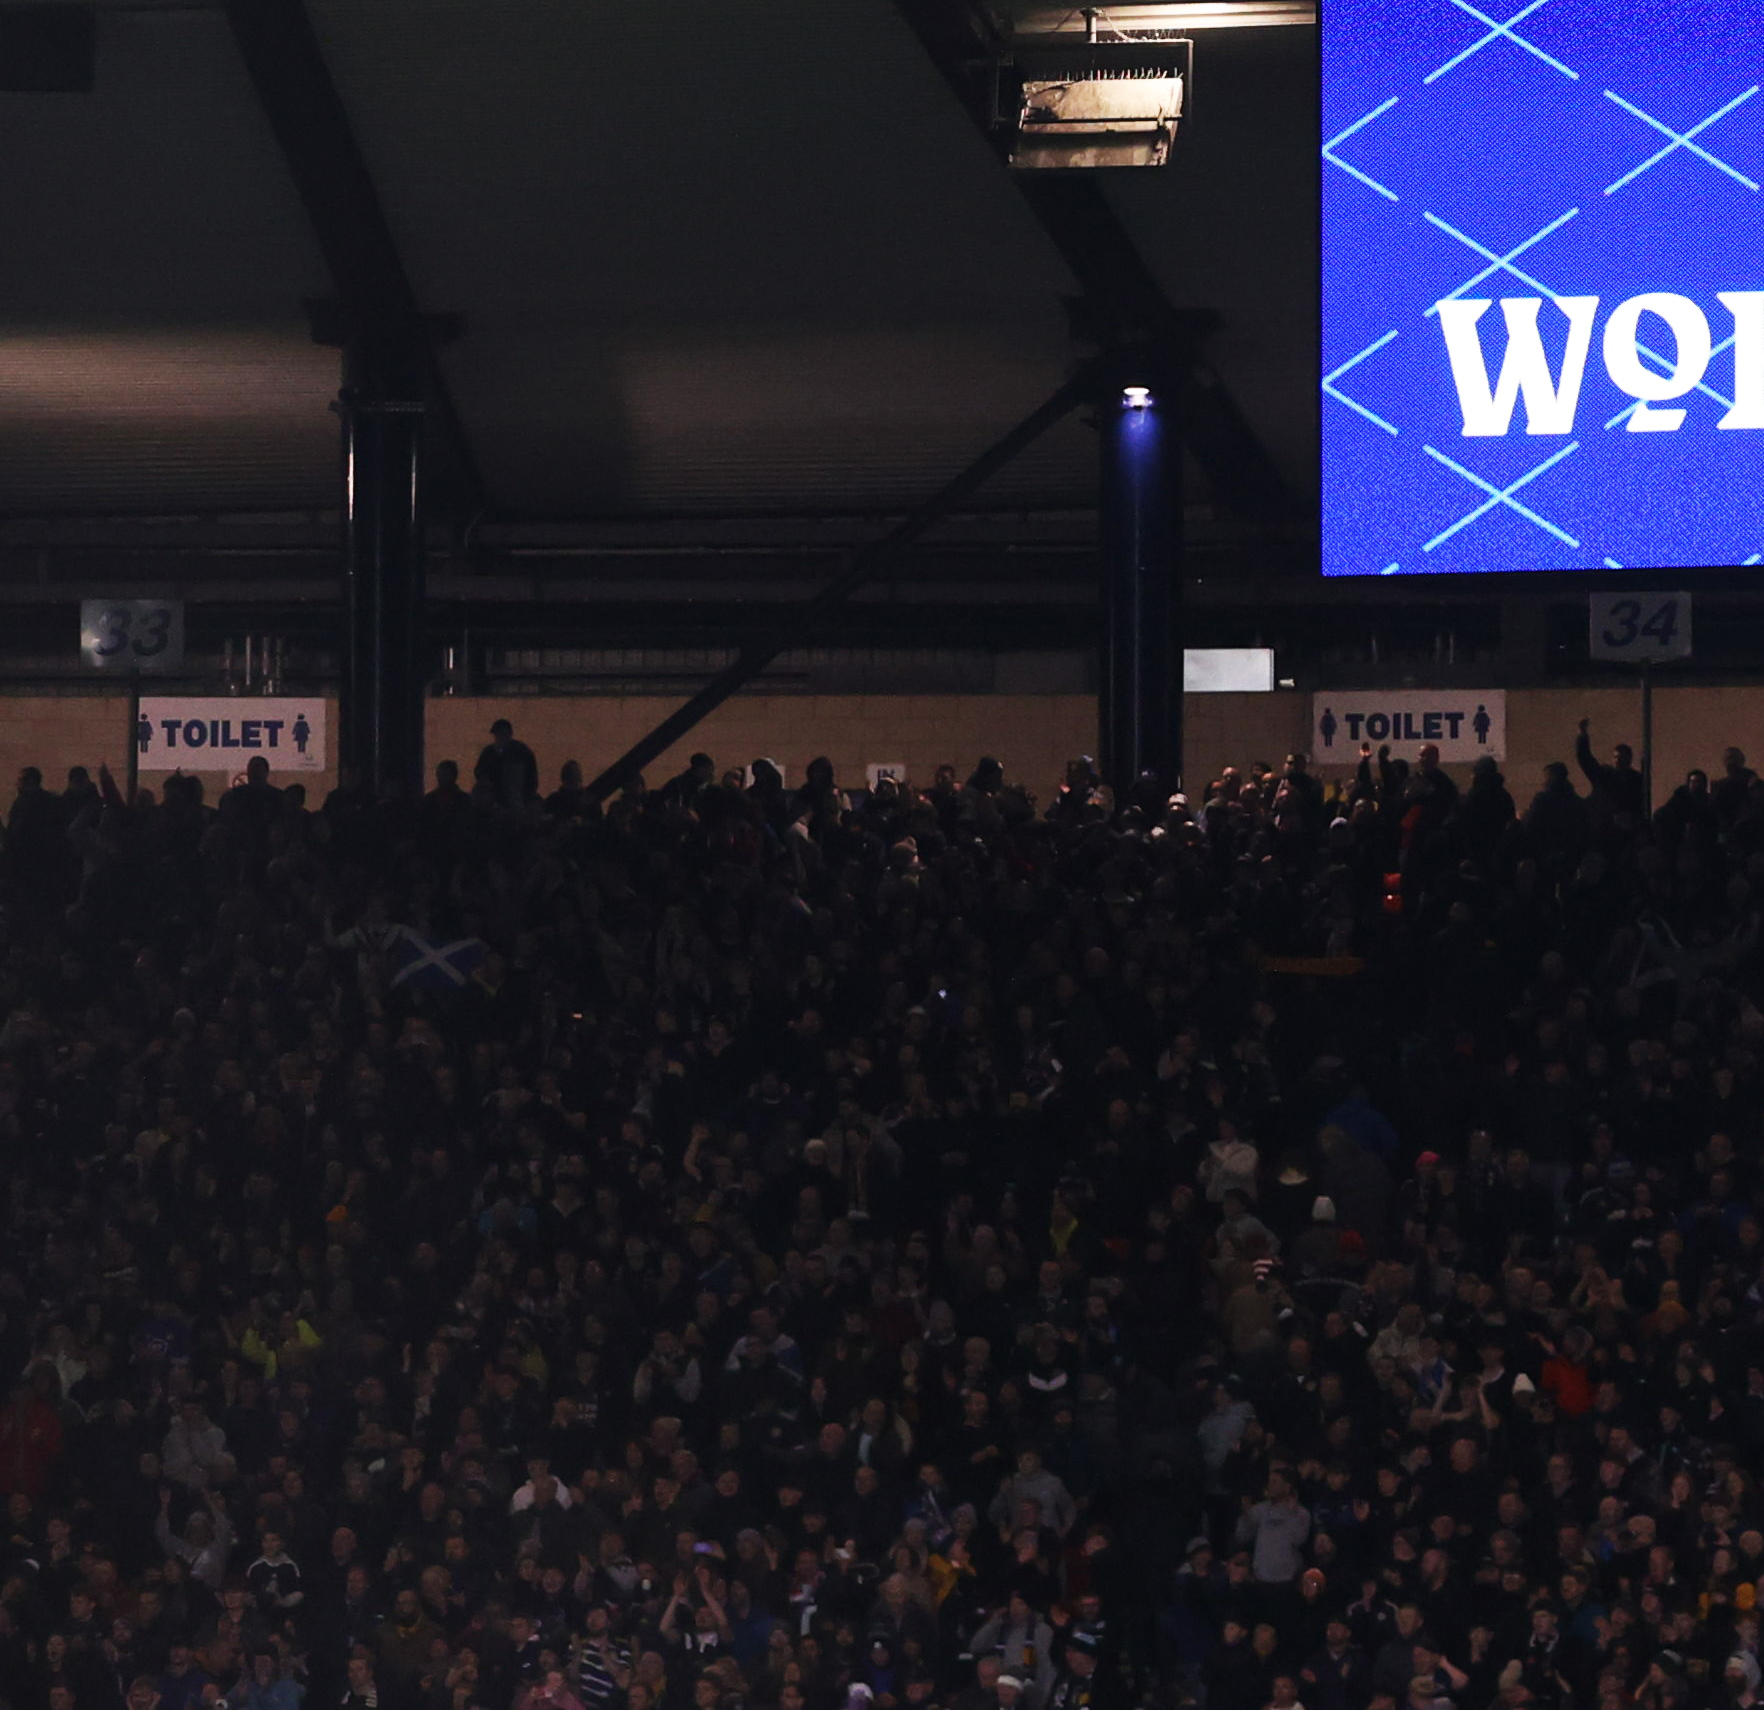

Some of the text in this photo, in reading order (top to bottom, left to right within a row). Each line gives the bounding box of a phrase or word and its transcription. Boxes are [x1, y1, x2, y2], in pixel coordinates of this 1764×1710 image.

[94, 608, 171, 656] 33
[1602, 599, 1679, 647] 34
[161, 719, 284, 748] TOILET
[1345, 712, 1465, 740] TOILET
